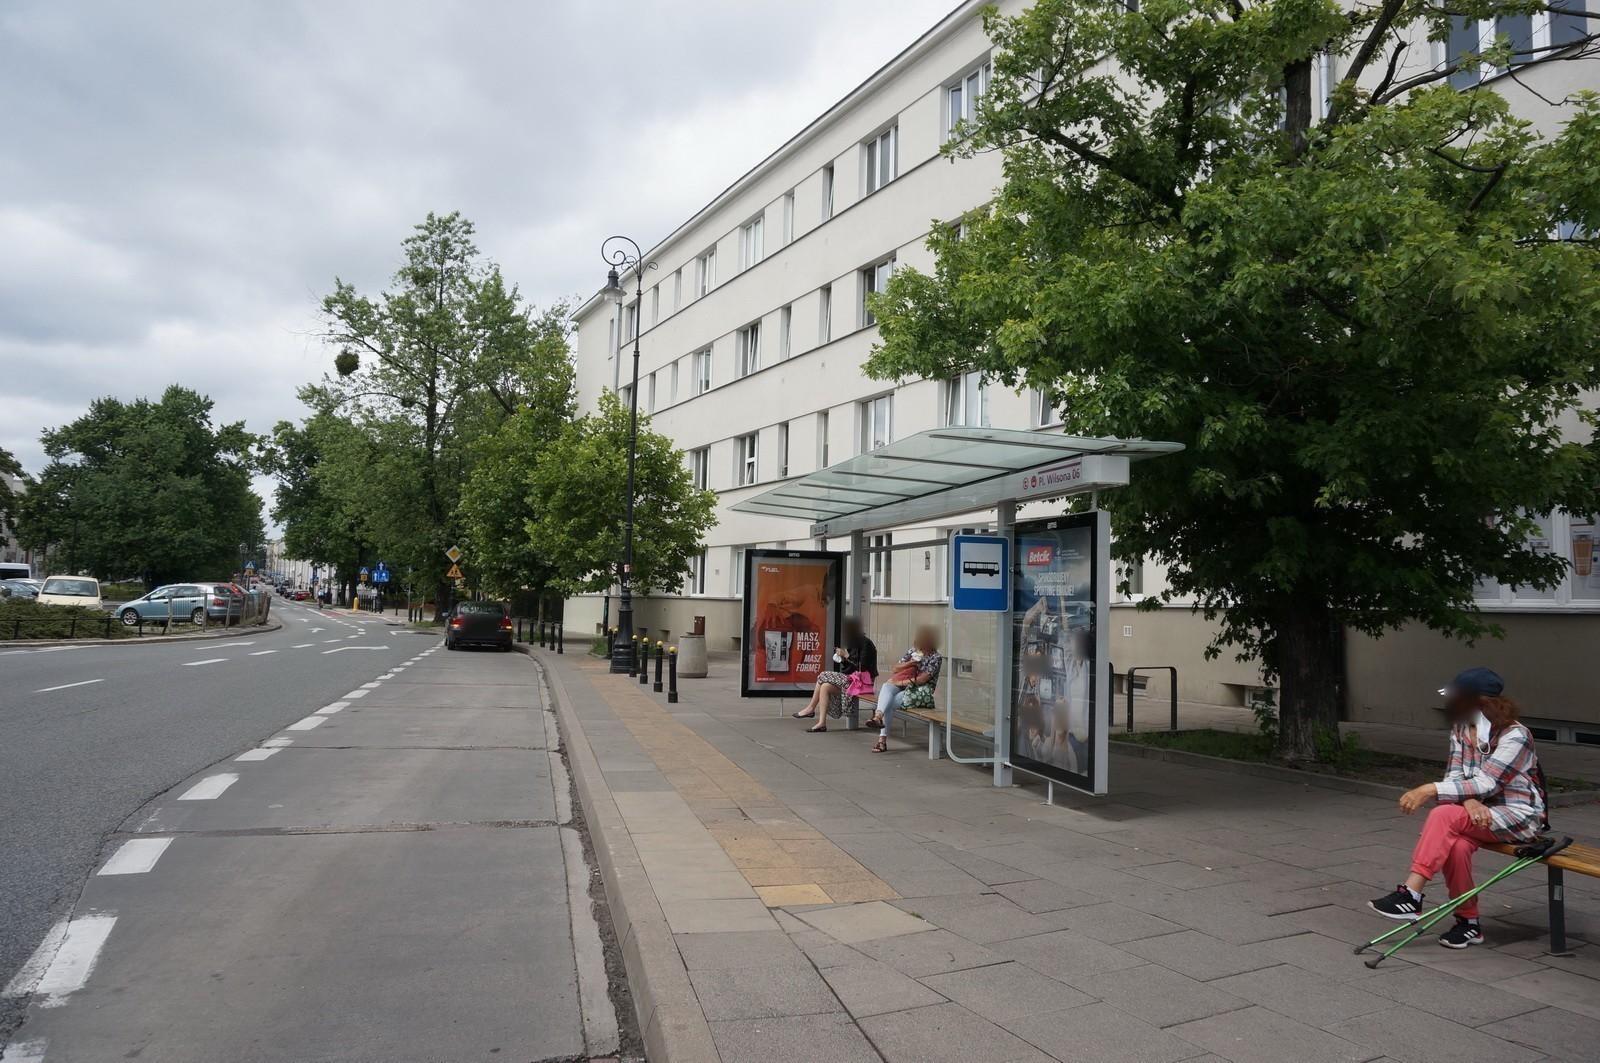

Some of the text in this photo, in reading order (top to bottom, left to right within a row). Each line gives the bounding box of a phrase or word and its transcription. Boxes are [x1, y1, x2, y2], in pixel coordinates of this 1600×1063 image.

[1047, 472, 1071, 485] Wilsona
[1071, 468, 1080, 479] 06
[1029, 550, 1050, 563] Betclic
[797, 632, 819, 642] MASZ
[797, 641, 820, 651] FUEL?
[804, 655, 822, 663] MASZ
